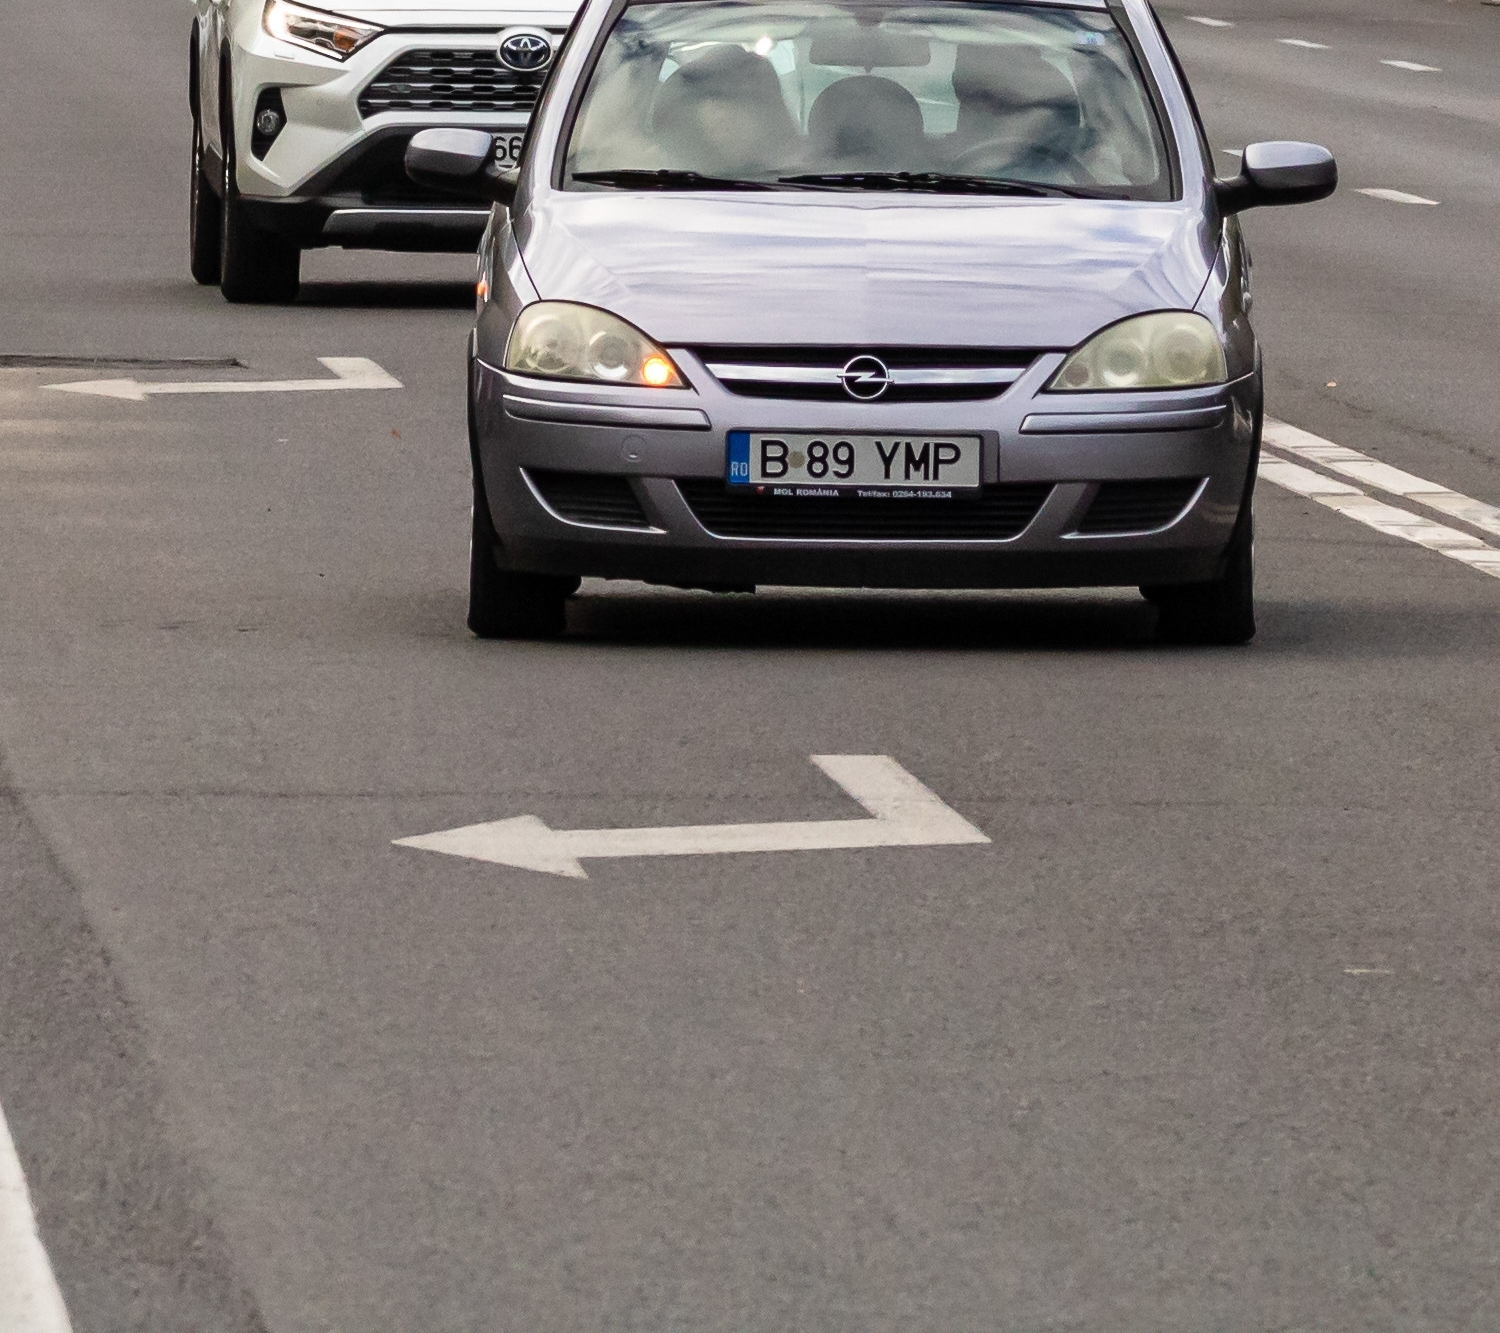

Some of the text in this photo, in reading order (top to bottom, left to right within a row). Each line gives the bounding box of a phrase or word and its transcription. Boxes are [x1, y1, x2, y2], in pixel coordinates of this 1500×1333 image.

[730, 439, 962, 482] RO B 89 YMP
[773, 487, 794, 496] MOL
